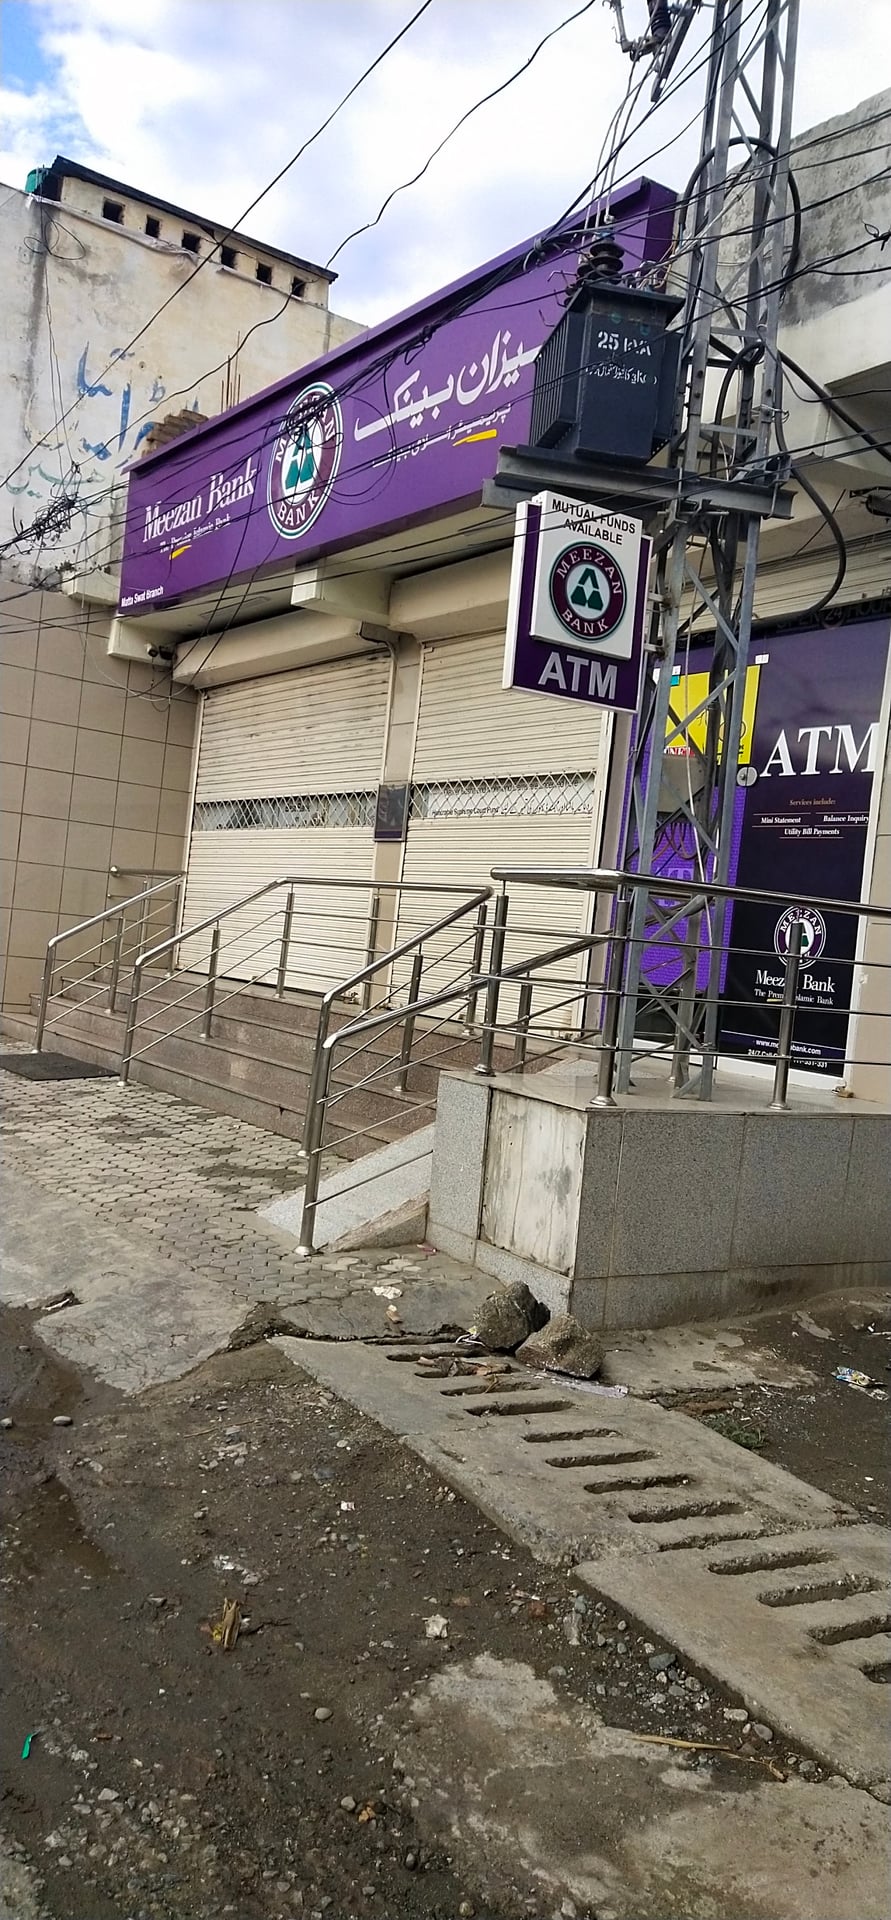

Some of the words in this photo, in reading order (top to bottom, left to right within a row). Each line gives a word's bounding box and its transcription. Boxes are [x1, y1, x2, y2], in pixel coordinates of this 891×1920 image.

[598, 331, 620, 351] 25
[457, 329, 543, 406] یزان
[354, 370, 455, 442] بینک
[142, 495, 203, 543] Meezan
[206, 457, 258, 514] Bank
[277, 490, 321, 527] BANK
[552, 498, 596, 524] MUTUAL
[600, 514, 636, 534] FUNDS
[564, 518, 623, 546] AVAILABLE
[556, 548, 622, 595] MEEZAN
[134, 590, 146, 604] Swat
[146, 585, 164, 600] Branch
[561, 608, 609, 634] BANK
[825, 608, 842, 621] 24
[537, 651, 618, 700] ATM
[759, 722, 880, 778] ATM
[813, 798, 836, 806] include:
[774, 816, 801, 824] Statement
[847, 814, 869, 824] Inquiry
[784, 828, 801, 837] Utility
[813, 828, 840, 837] Payments
[754, 988, 766, 998] The
[817, 996, 834, 1005] Bank
[802, 974, 836, 993] Bank
